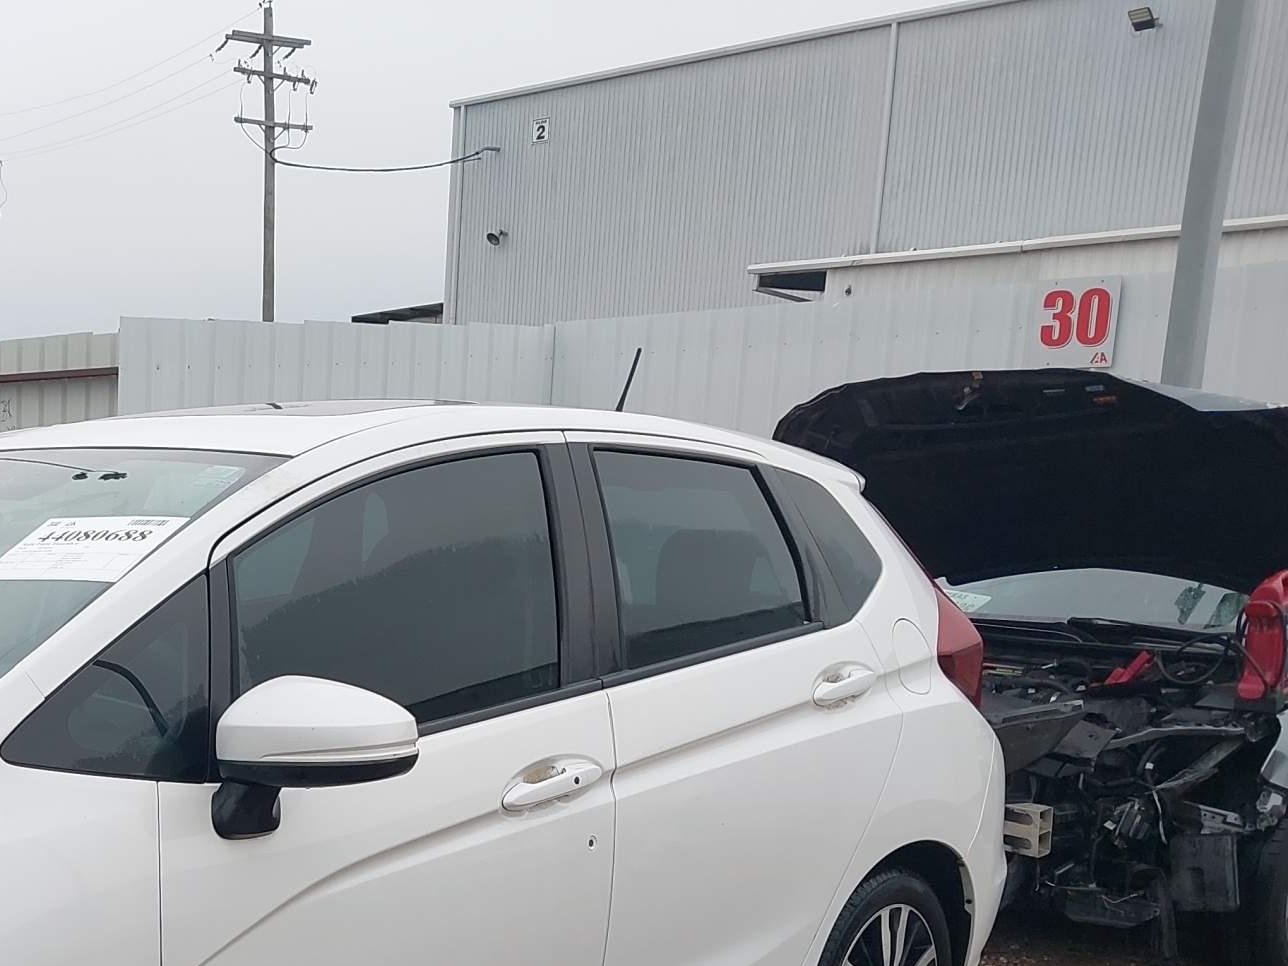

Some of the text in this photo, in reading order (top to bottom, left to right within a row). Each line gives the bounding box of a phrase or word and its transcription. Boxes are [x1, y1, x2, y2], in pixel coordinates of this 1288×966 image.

[536, 125, 546, 140] 2
[1039, 287, 1112, 348] 30
[38, 529, 153, 542] 44080688
